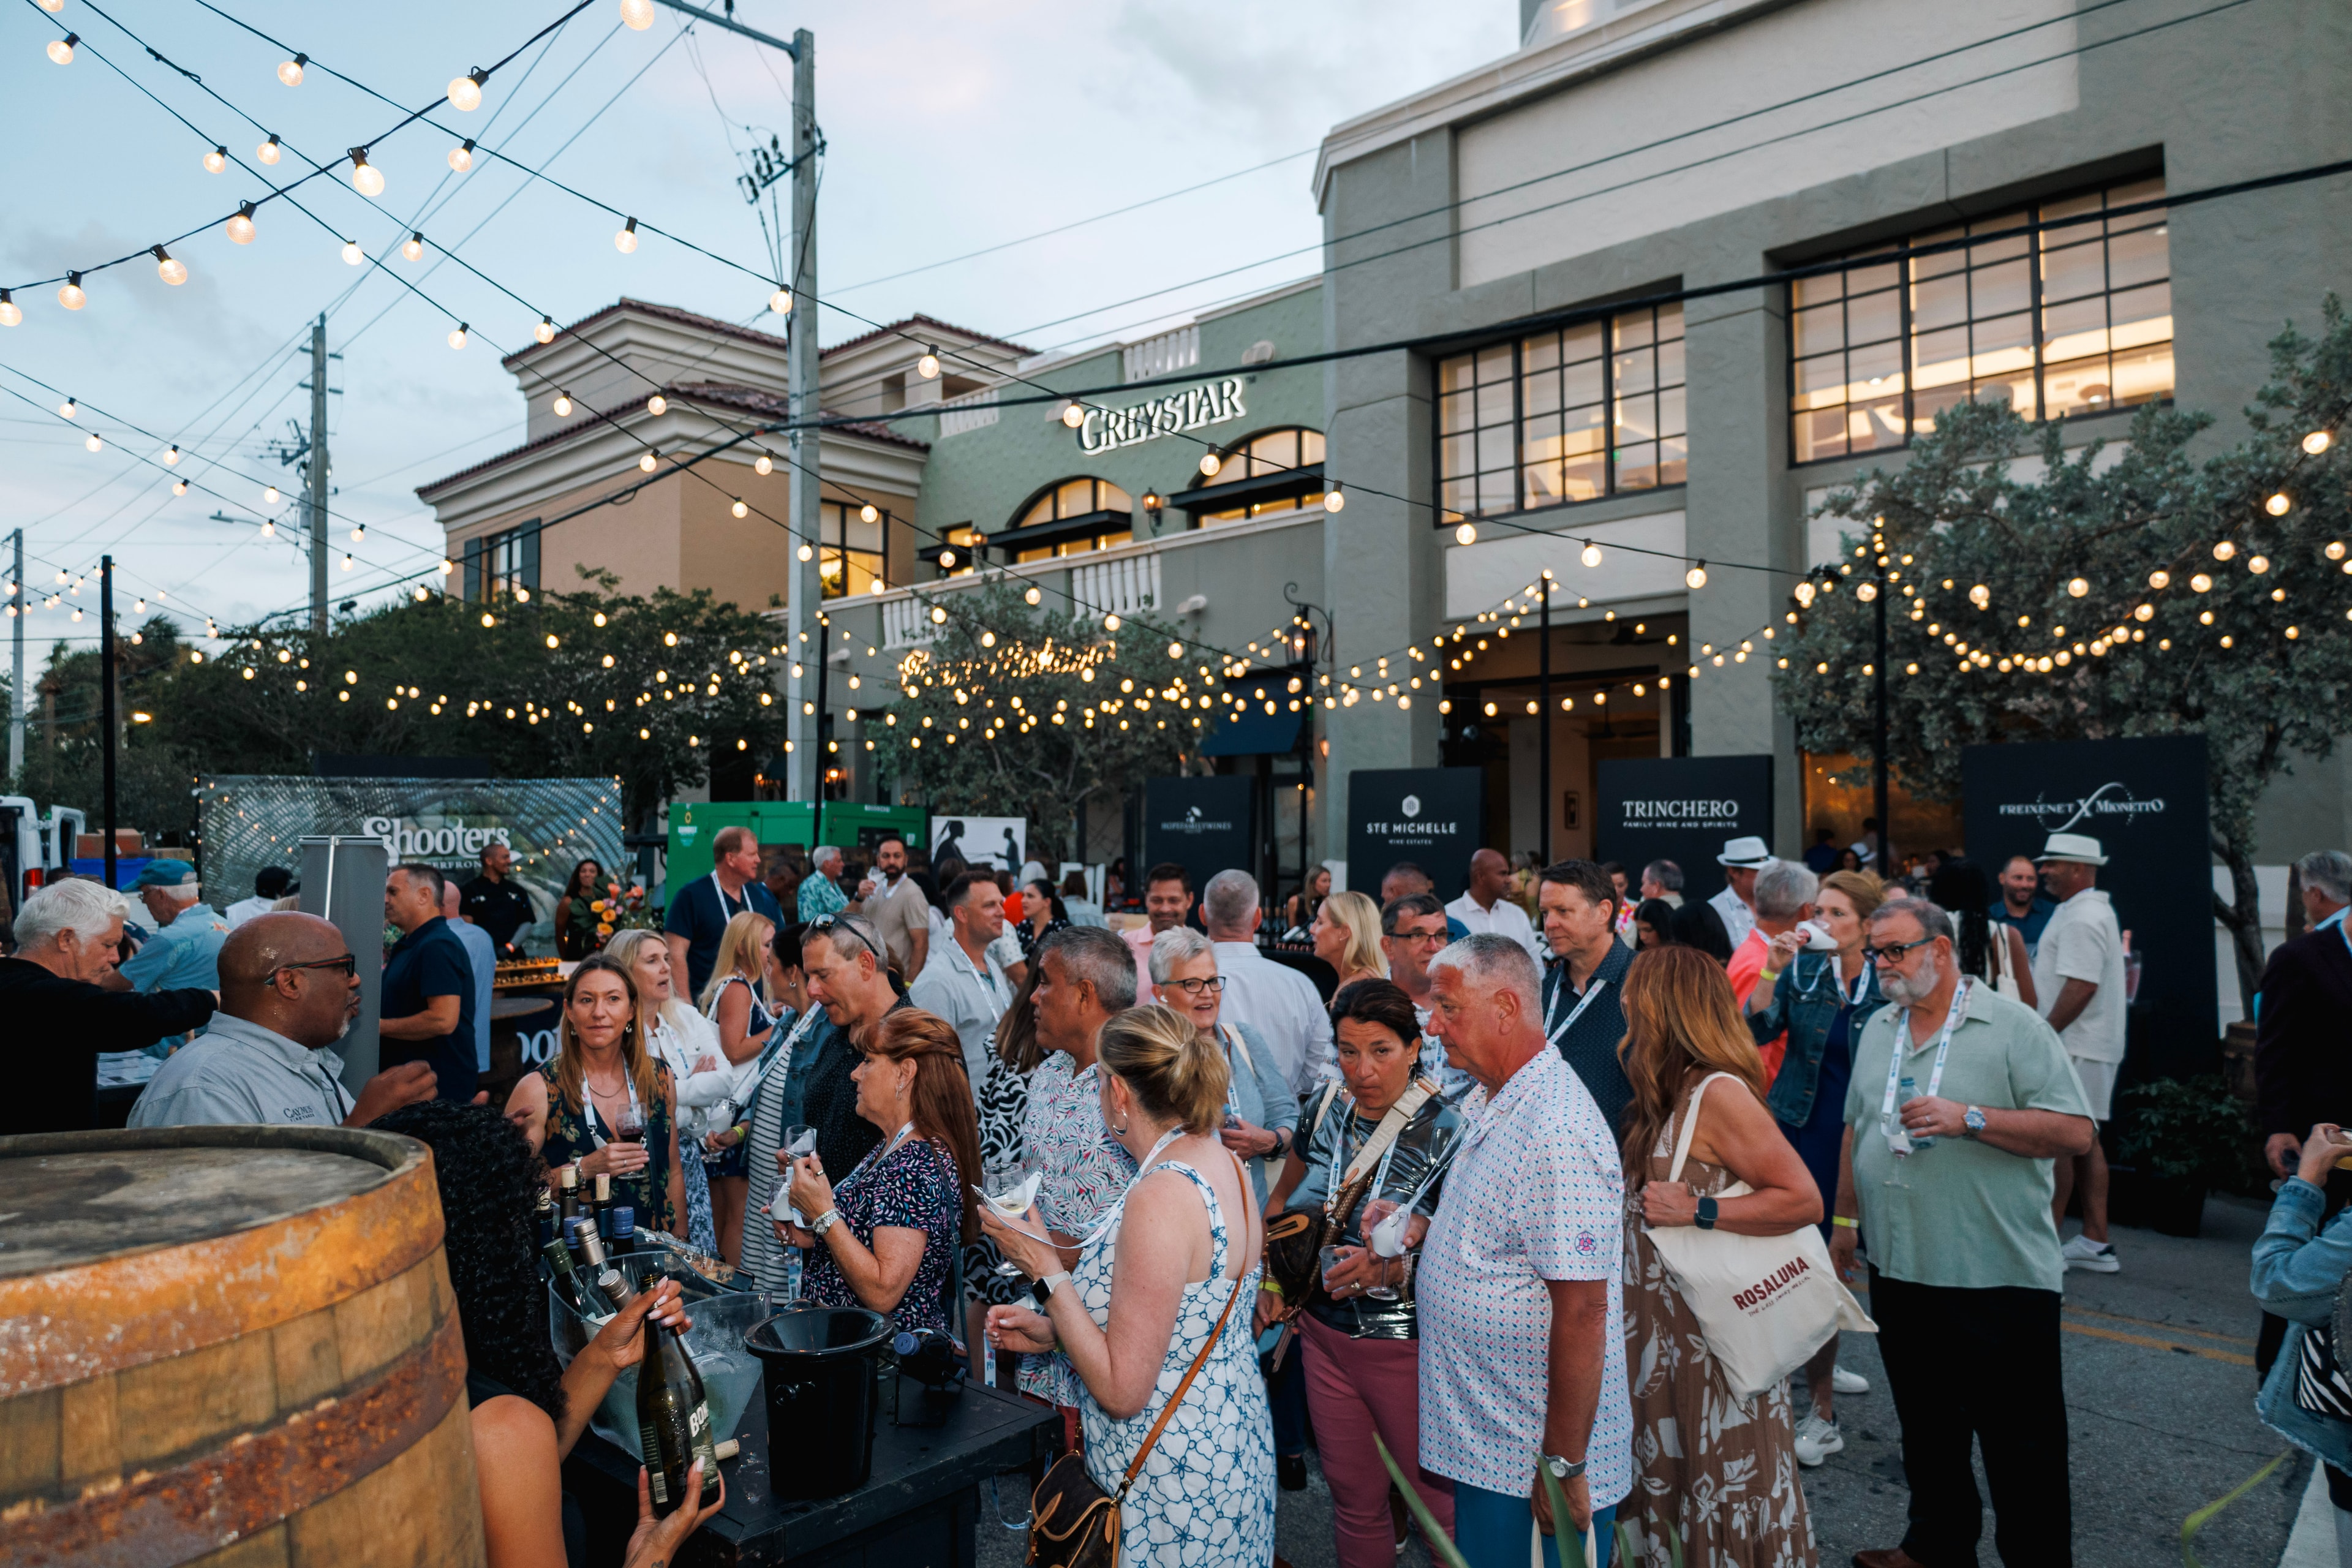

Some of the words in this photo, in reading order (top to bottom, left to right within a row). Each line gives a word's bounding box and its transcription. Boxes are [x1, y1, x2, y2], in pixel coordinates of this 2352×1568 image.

[1078, 378, 1246, 456] GREYSTAR
[1623, 799, 1739, 818] TRINCHERO
[1999, 804, 2075, 815] FREIXENET
[363, 816, 511, 867] Shooters
[1366, 822, 1389, 834] STE
[1392, 822, 1457, 834] MICHELLE
[1357, 1124, 1397, 1170] LOUIS
[1732, 1256, 1810, 1310] ROSALUNA
[1748, 1308, 1760, 1317] THE
